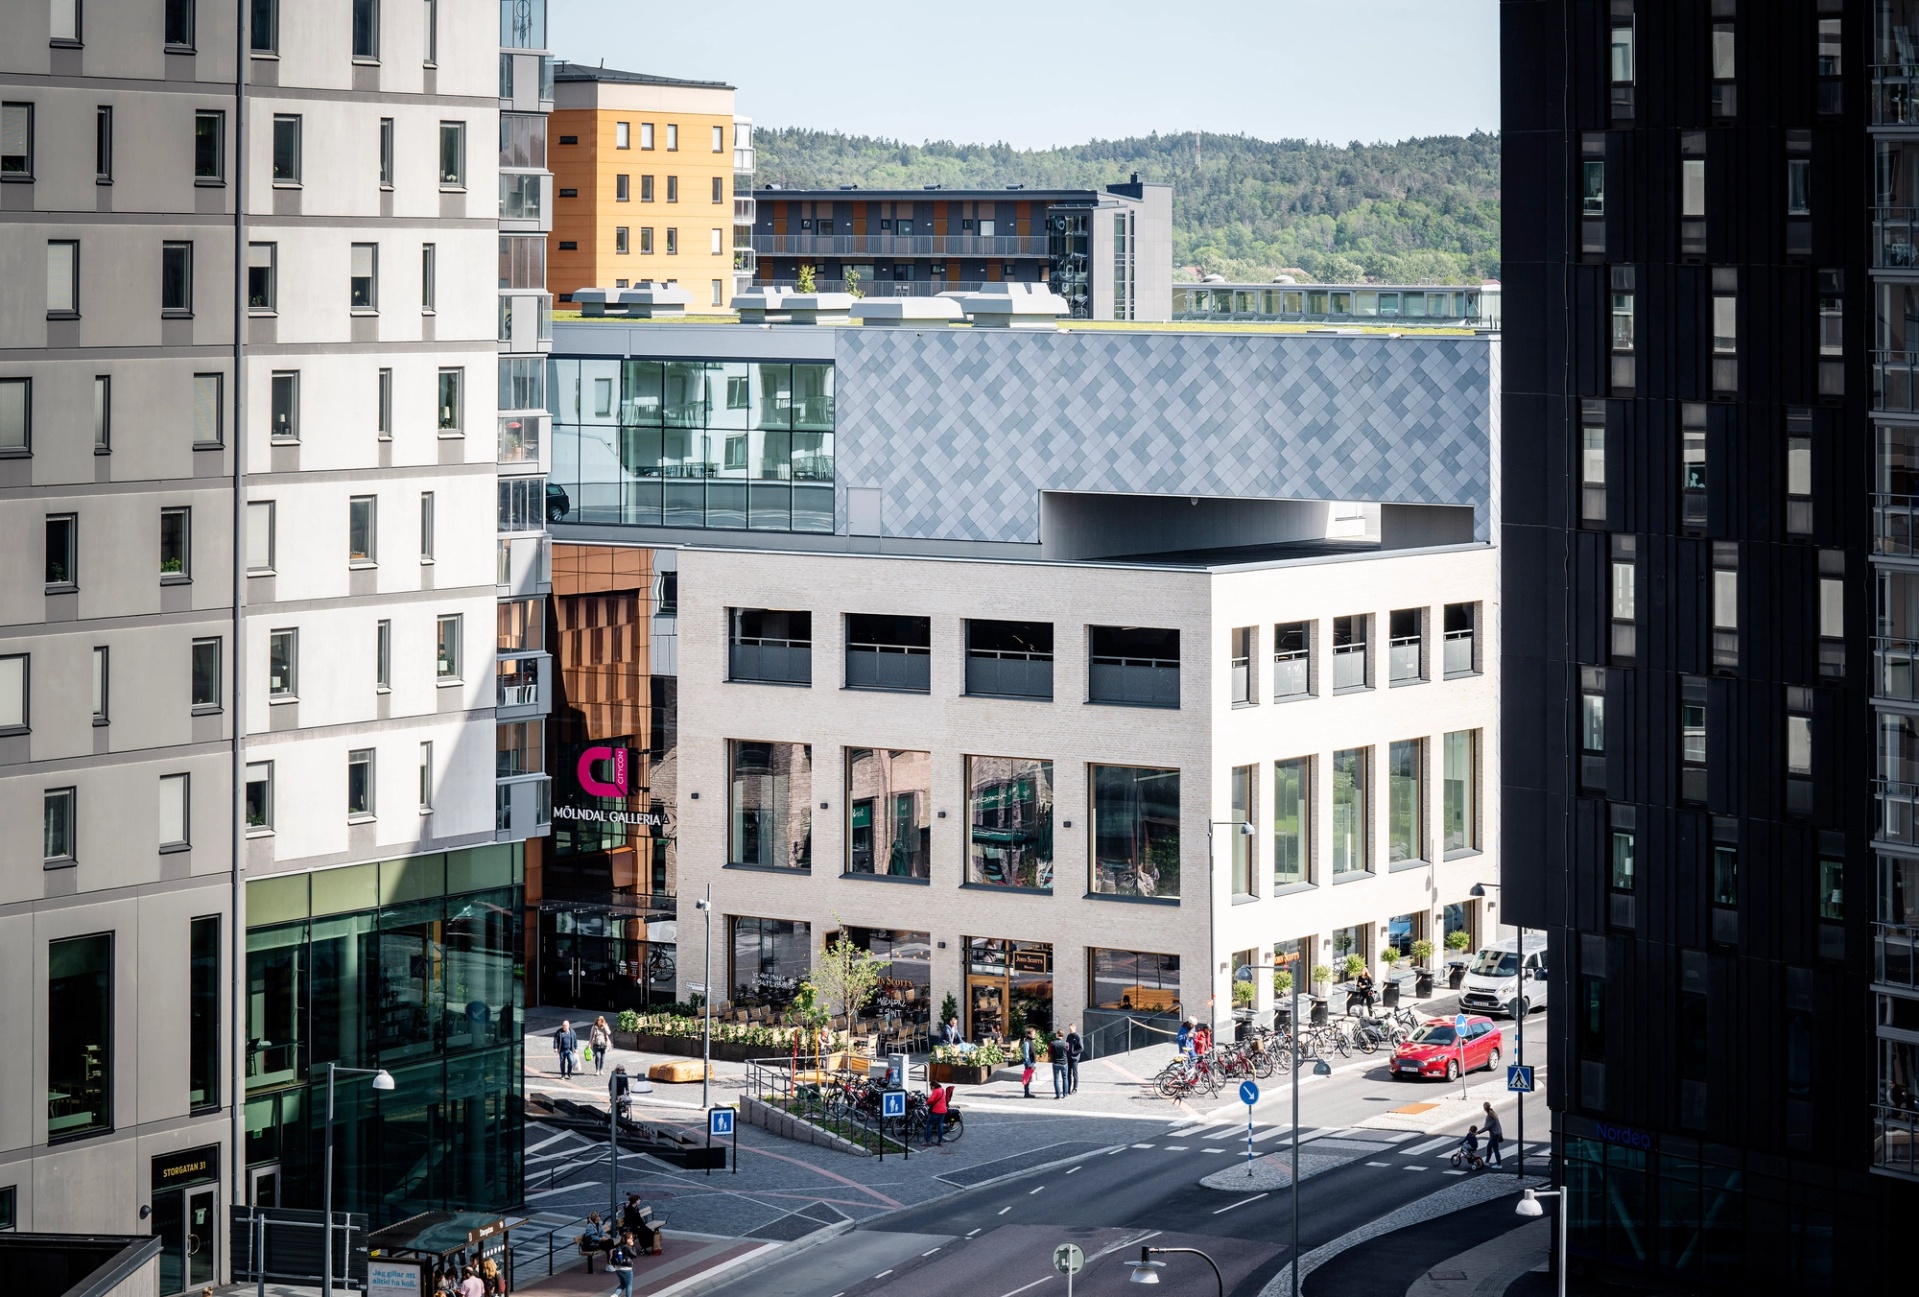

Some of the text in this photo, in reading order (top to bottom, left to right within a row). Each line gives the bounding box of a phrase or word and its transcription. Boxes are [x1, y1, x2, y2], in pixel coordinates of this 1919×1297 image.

[554, 806, 661, 826] MÖLNDAL GALLERIA
[1595, 1123, 1650, 1148] Nordea
[163, 1161, 205, 1178] STORGATAN 31
[372, 1269, 386, 1278] Jag
[386, 1270, 404, 1279] gillar
